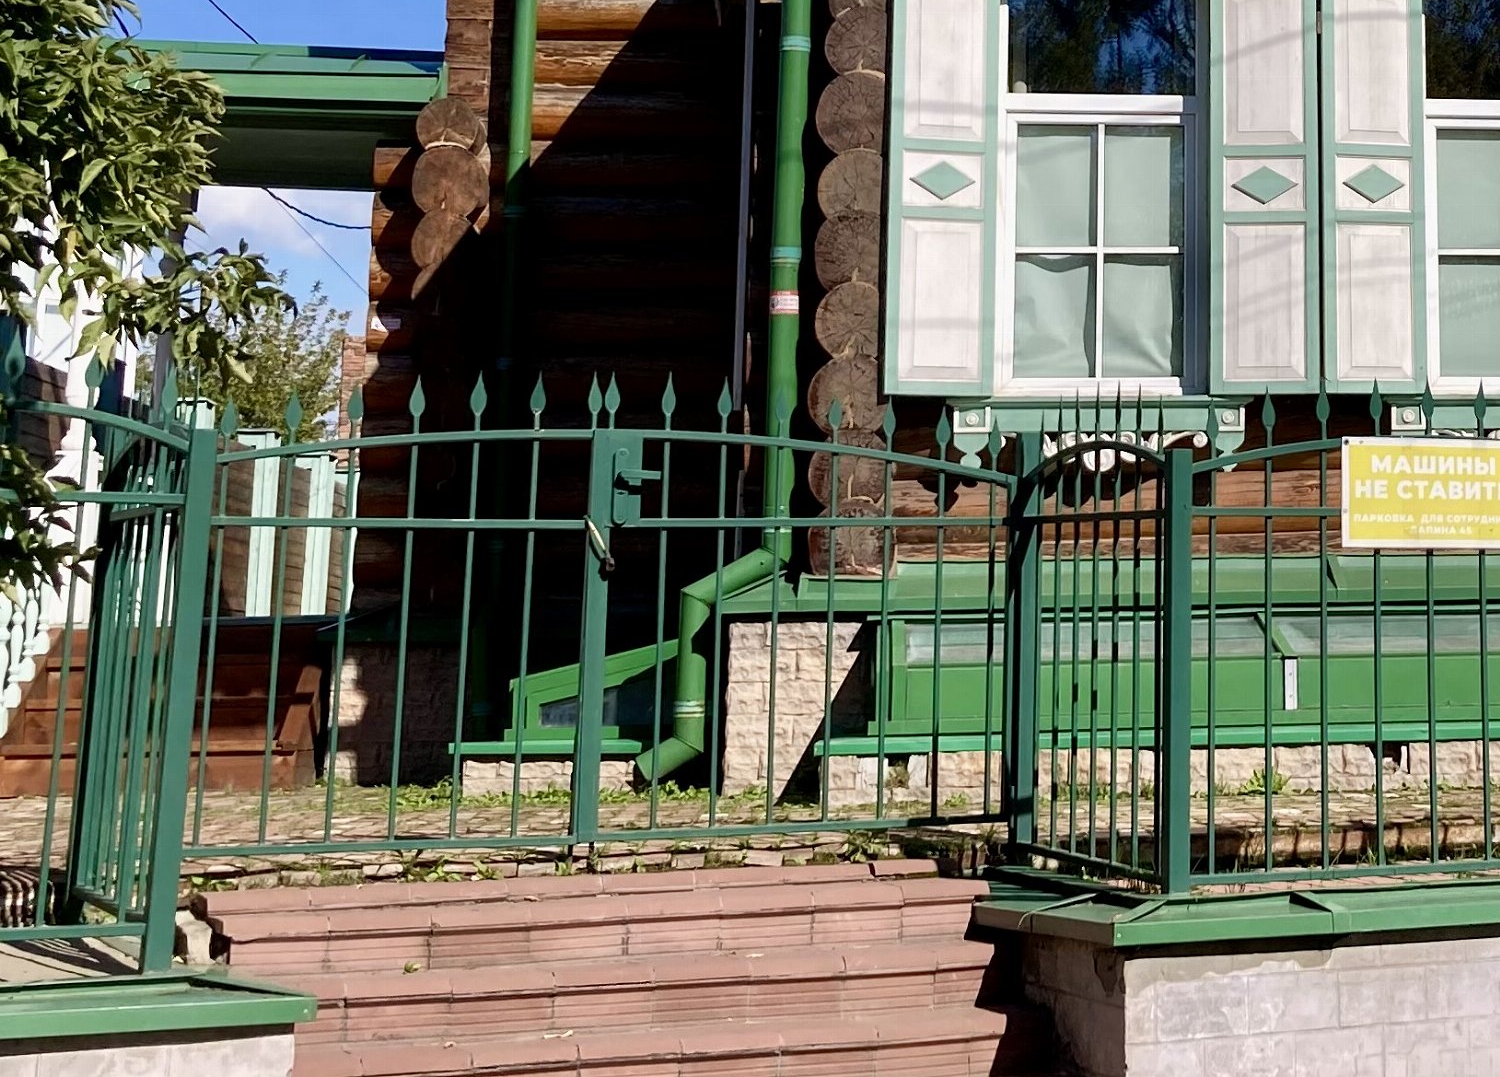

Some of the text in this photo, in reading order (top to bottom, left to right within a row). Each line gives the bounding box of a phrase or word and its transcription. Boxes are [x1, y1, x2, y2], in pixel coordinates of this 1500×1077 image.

[1371, 454, 1496, 476] МАШИНЫ
[1354, 479, 1388, 499] НЕ
[1354, 513, 1414, 523] ПАРКОВКА
[1421, 514, 1444, 525] ДЛЯ
